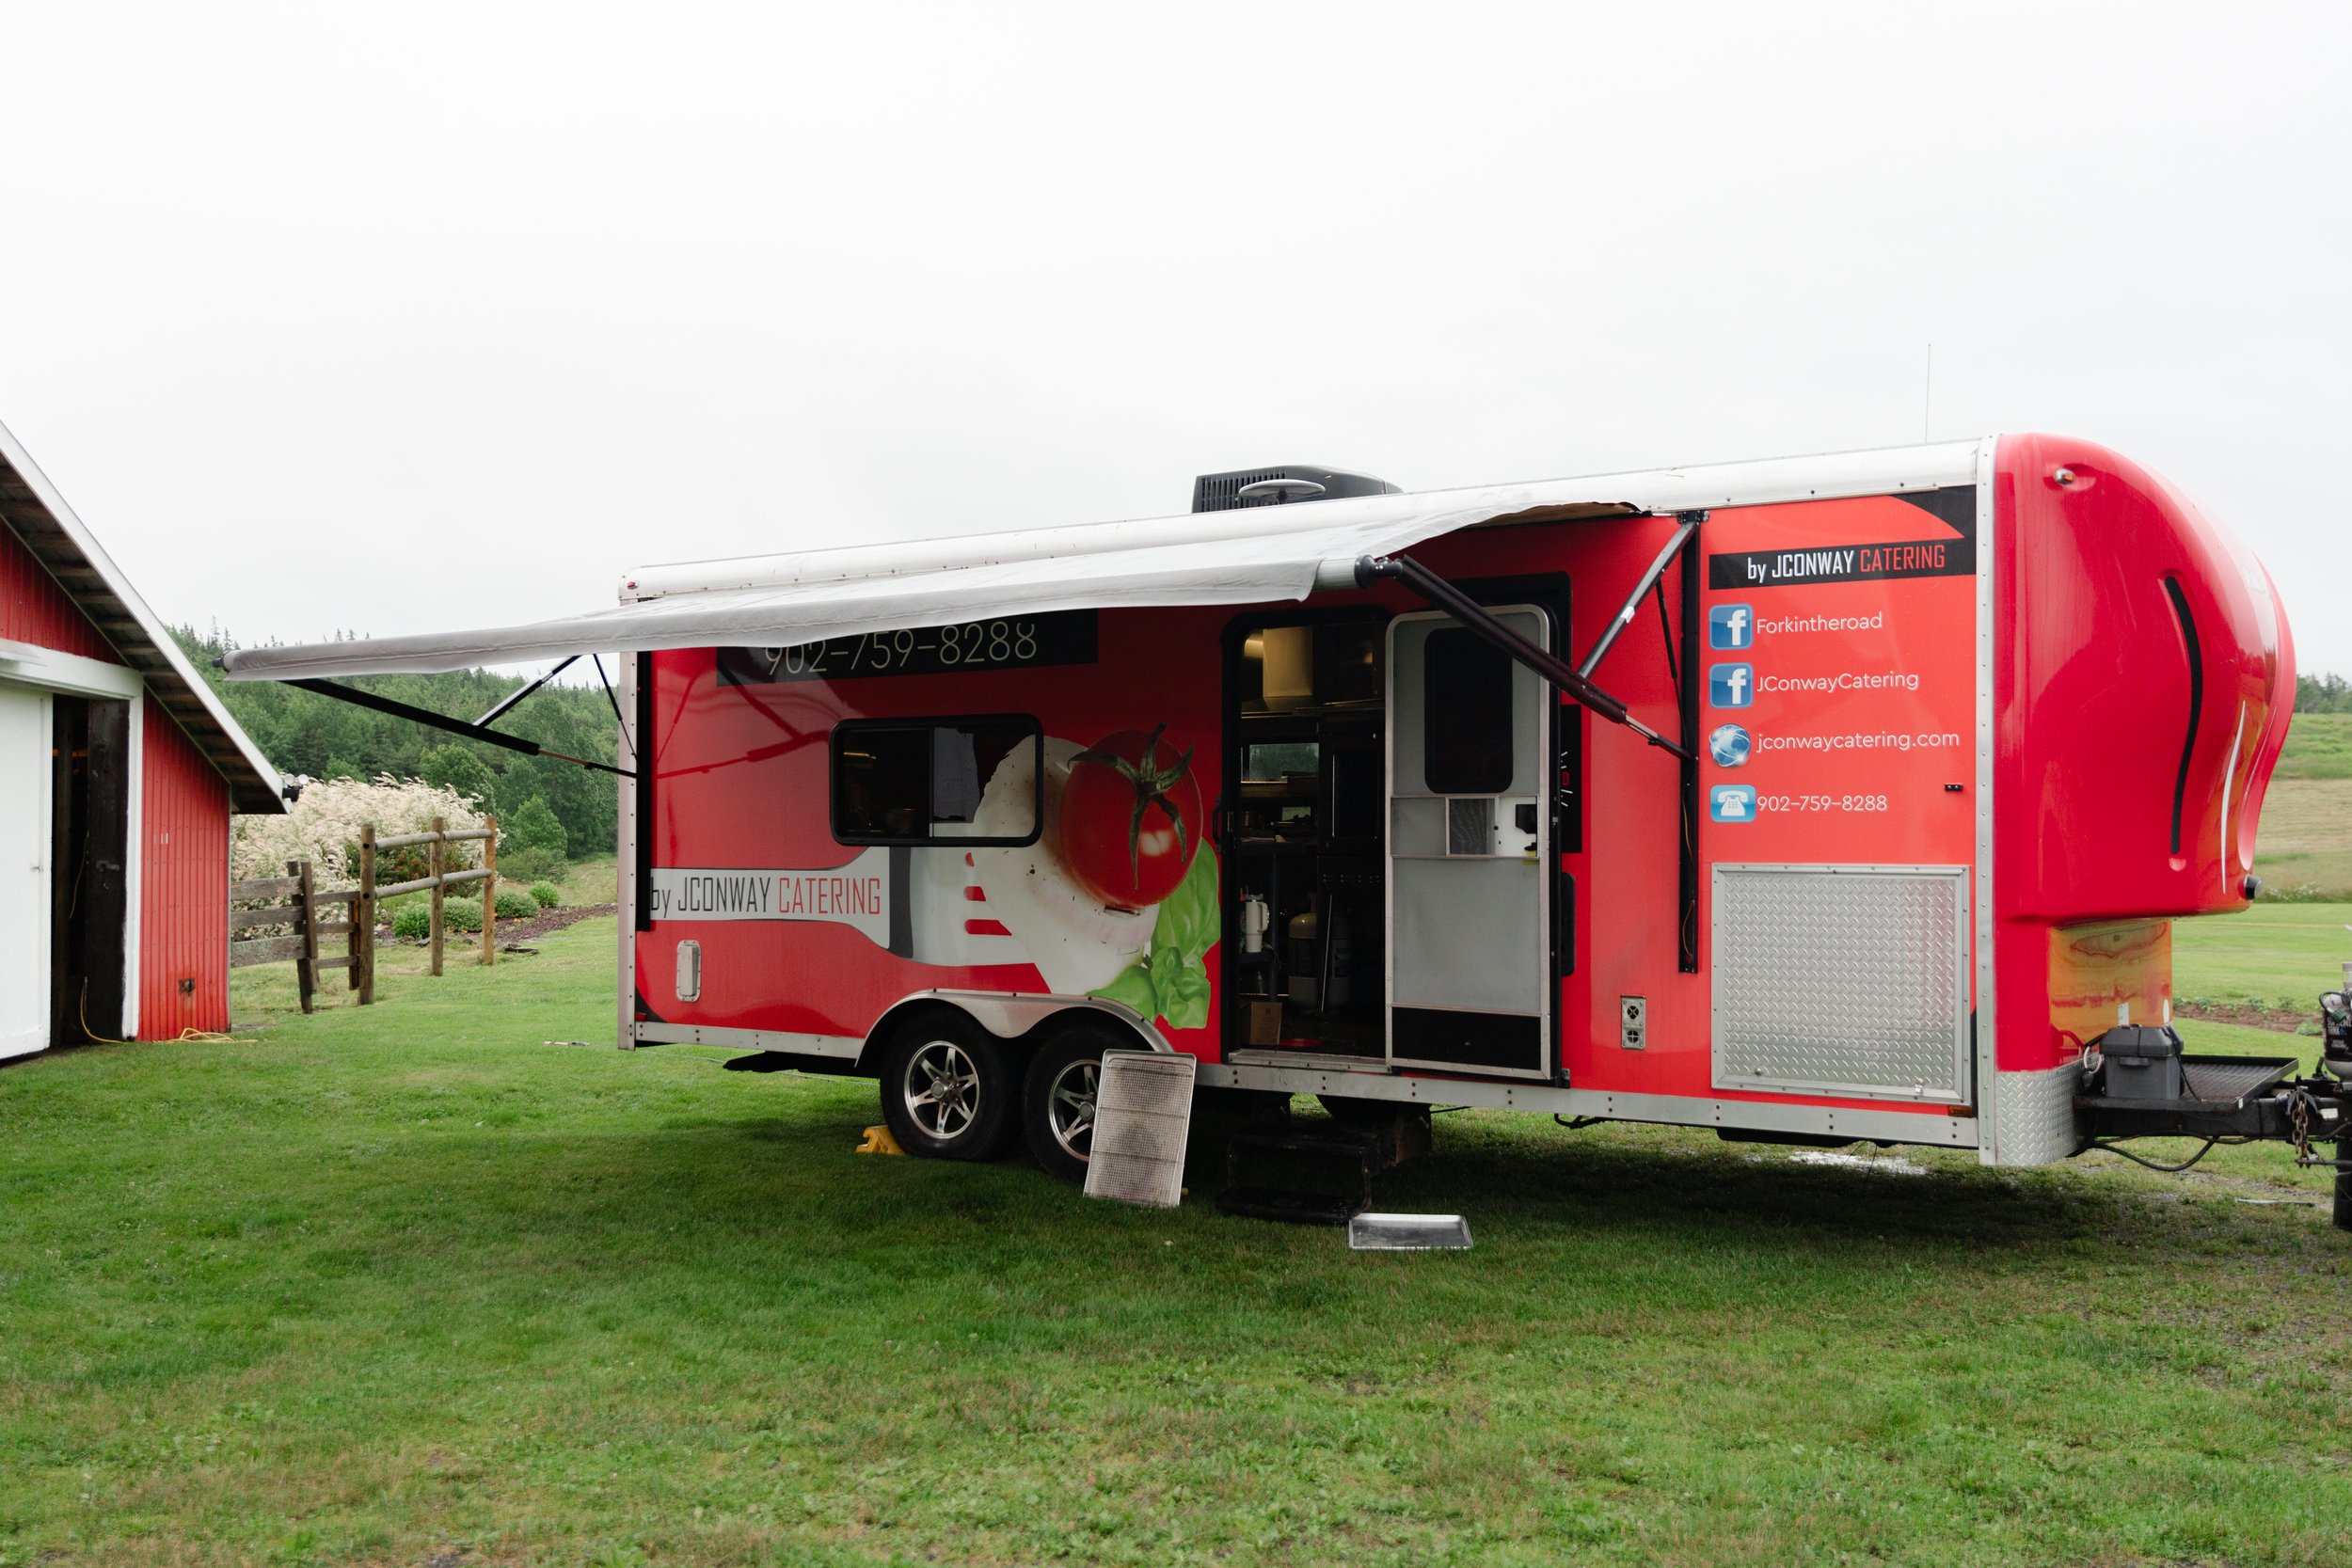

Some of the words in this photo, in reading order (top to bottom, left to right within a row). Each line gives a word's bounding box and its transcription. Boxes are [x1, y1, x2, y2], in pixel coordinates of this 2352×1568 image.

[1747, 557, 1767, 583] by
[1772, 549, 1854, 578] JCONWAY
[1860, 544, 1945, 573] CATERING
[1756, 611, 1883, 634] Forkintheroad
[1756, 671, 1919, 692] JConwayCatering
[1756, 731, 1960, 752] jconwaycatering.com
[1757, 795, 1887, 813] 902-759-8288
[678, 877, 771, 912] JCONWAY
[779, 878, 881, 915] CATERING
